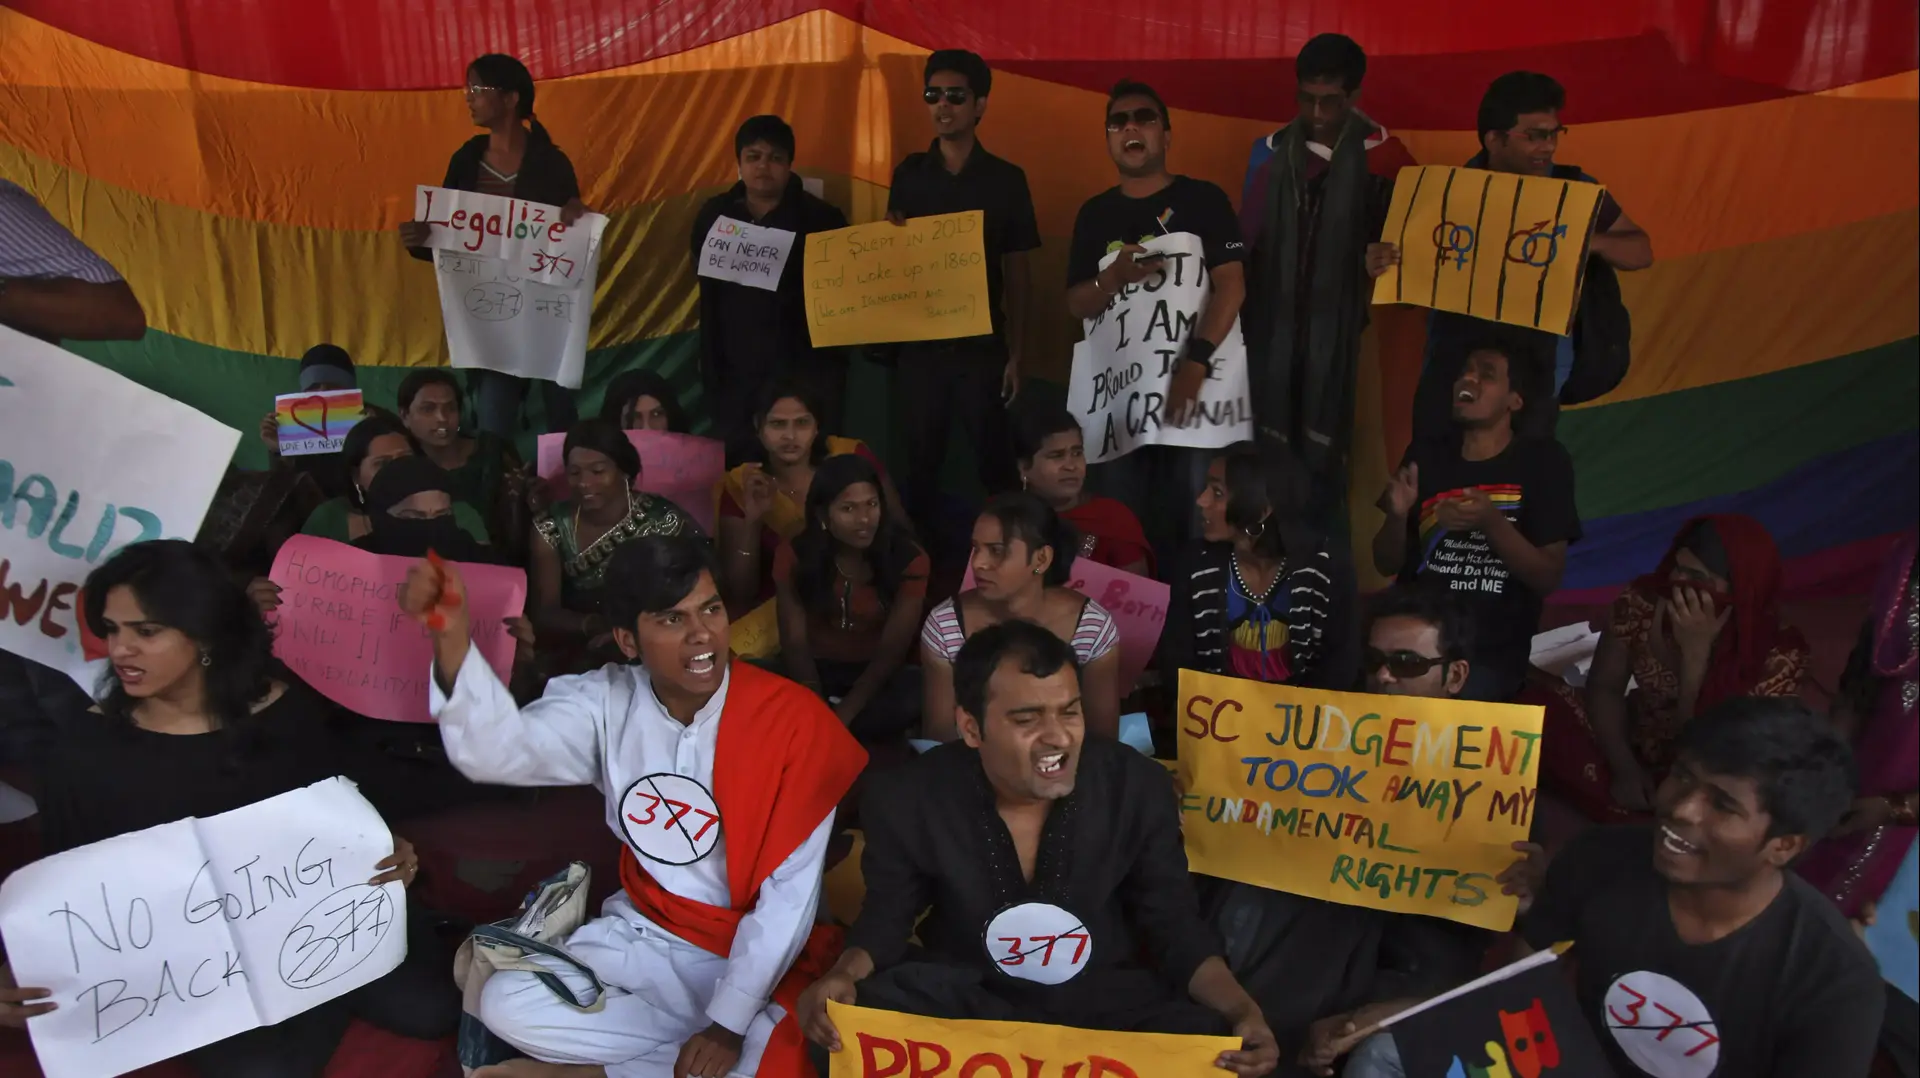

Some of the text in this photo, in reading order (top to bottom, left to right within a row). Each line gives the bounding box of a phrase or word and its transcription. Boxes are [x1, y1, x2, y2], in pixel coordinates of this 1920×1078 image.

[708, 237, 779, 260] CAN NEVER
[717, 221, 749, 239] LOVE
[814, 235, 836, 264] I
[932, 214, 976, 241] 2013
[1225, 241, 1244, 249] Goo
[529, 251, 576, 279] 377
[709, 253, 771, 277] BE WRONG
[812, 263, 844, 289] and
[857, 261, 895, 284] woke
[903, 264, 924, 283] up
[943, 251, 981, 271] 1860
[469, 287, 522, 316] 377
[1142, 299, 1199, 342] AM
[1098, 391, 1253, 458] A CRNAL
[285, 550, 407, 601] HOMOPHO
[1450, 578, 1504, 594] and ME
[1464, 564, 1481, 576] Da
[389, 611, 406, 634] IF
[1183, 695, 1541, 777] SC JUDGEMENT
[627, 792, 720, 842] 377
[1240, 756, 1536, 840] TOOK AWAY MY
[1329, 854, 1498, 907] RIGHTS
[49, 837, 336, 974] NO GOING
[76, 893, 389, 1044] BACK 377
[996, 934, 1090, 967] 377
[1607, 982, 1720, 1057] 377
